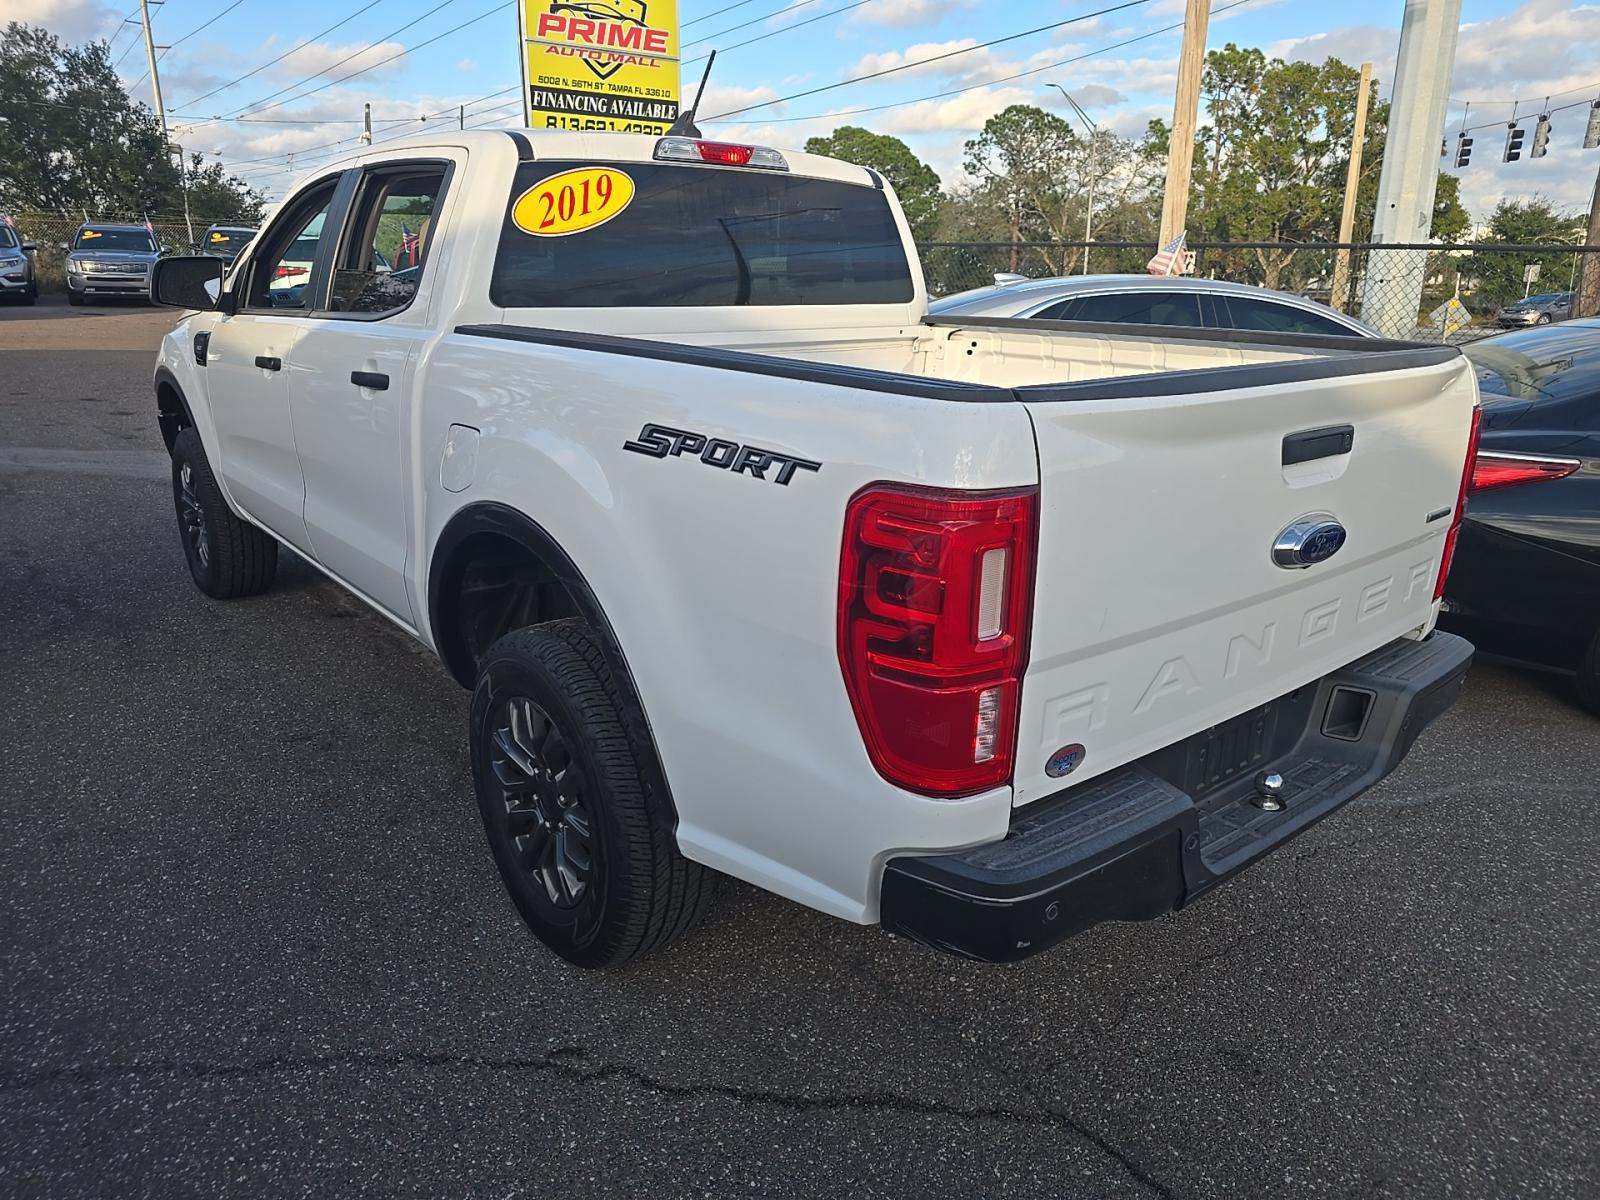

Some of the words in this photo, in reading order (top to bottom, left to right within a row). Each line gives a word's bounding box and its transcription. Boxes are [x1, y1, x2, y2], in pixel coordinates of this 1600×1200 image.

[537, 13, 669, 53] PRIME
[545, 45, 602, 61] AUTO
[607, 52, 661, 68] MALL
[533, 90, 608, 115] FINANCING
[610, 99, 677, 120] AVAILABLE
[538, 75, 561, 86] 5002
[562, 78, 570, 87] N.
[571, 79, 593, 89] 56TH
[594, 81, 605, 91] ST
[608, 83, 633, 94] TAMPA
[634, 87, 644, 95] FL
[645, 87, 671, 98] 33610
[538, 174, 612, 230] 2019
[622, 423, 823, 486] SPORT
[1042, 556, 1435, 748] RANGER
